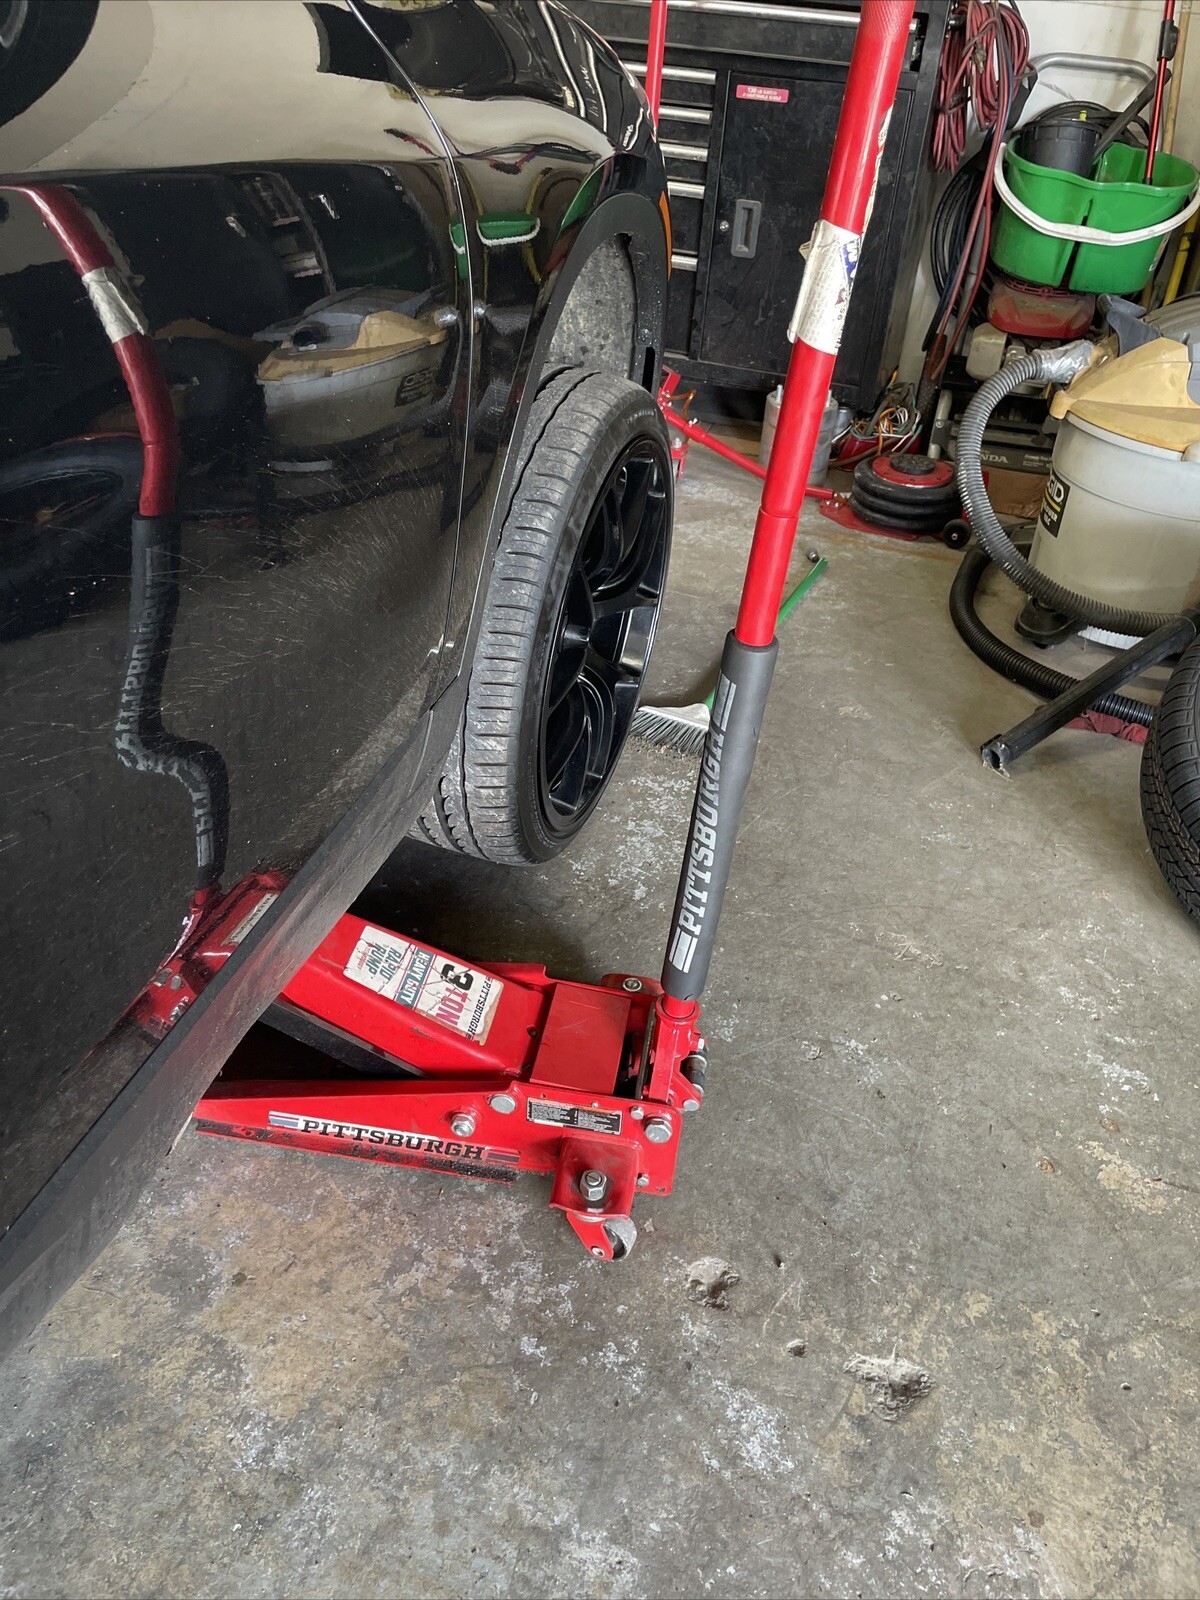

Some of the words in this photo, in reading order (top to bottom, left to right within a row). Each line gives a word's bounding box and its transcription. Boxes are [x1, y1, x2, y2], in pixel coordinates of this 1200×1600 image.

[677, 722, 726, 937] PITTSBURGH
[365, 942, 387, 975] PUMP
[380, 947, 402, 979] RAPID
[411, 951, 431, 980] HEAVY
[400, 979, 420, 1004] DUTY
[441, 963, 474, 991] 3
[434, 986, 467, 1026] TON
[467, 980, 493, 1035] PITTSBURGH
[301, 1118, 485, 1161] PITTSBURGH
